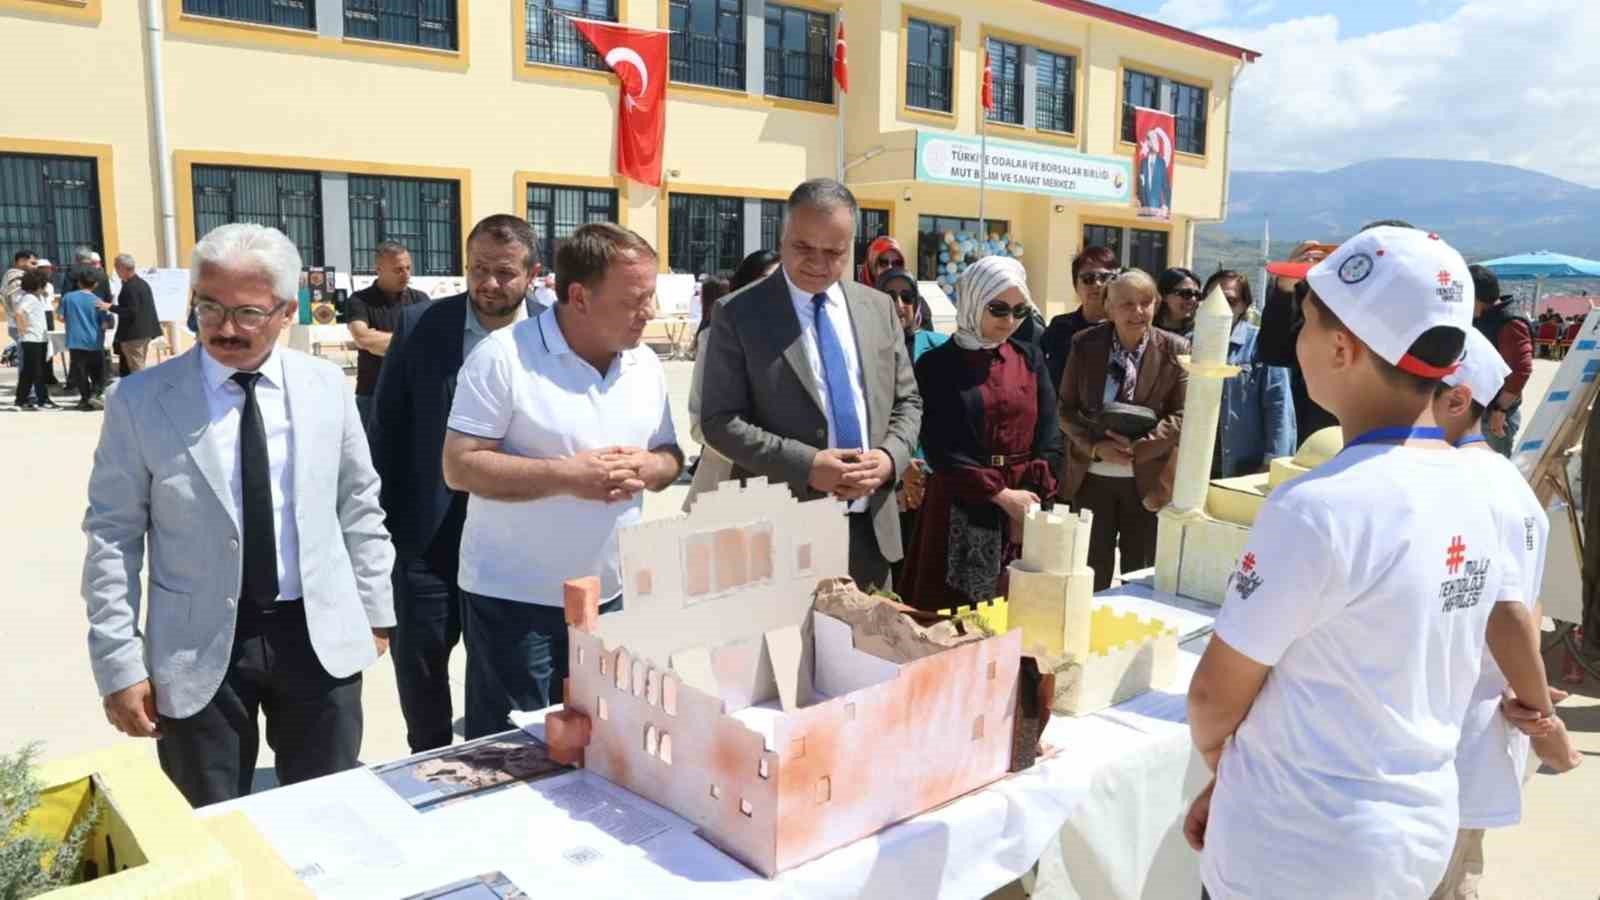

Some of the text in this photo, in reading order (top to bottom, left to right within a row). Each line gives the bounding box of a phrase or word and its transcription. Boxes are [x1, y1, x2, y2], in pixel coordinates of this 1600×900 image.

[952, 149, 990, 165] TÜRKİE
[991, 156, 1027, 169] ODALAR
[1029, 160, 1040, 171] VE
[1041, 162, 1081, 176] BORSALAR
[951, 166, 971, 178] MUT
[974, 168, 999, 181] BLİM
[1001, 171, 1012, 183] VE
[1013, 173, 1040, 186] SANAT
